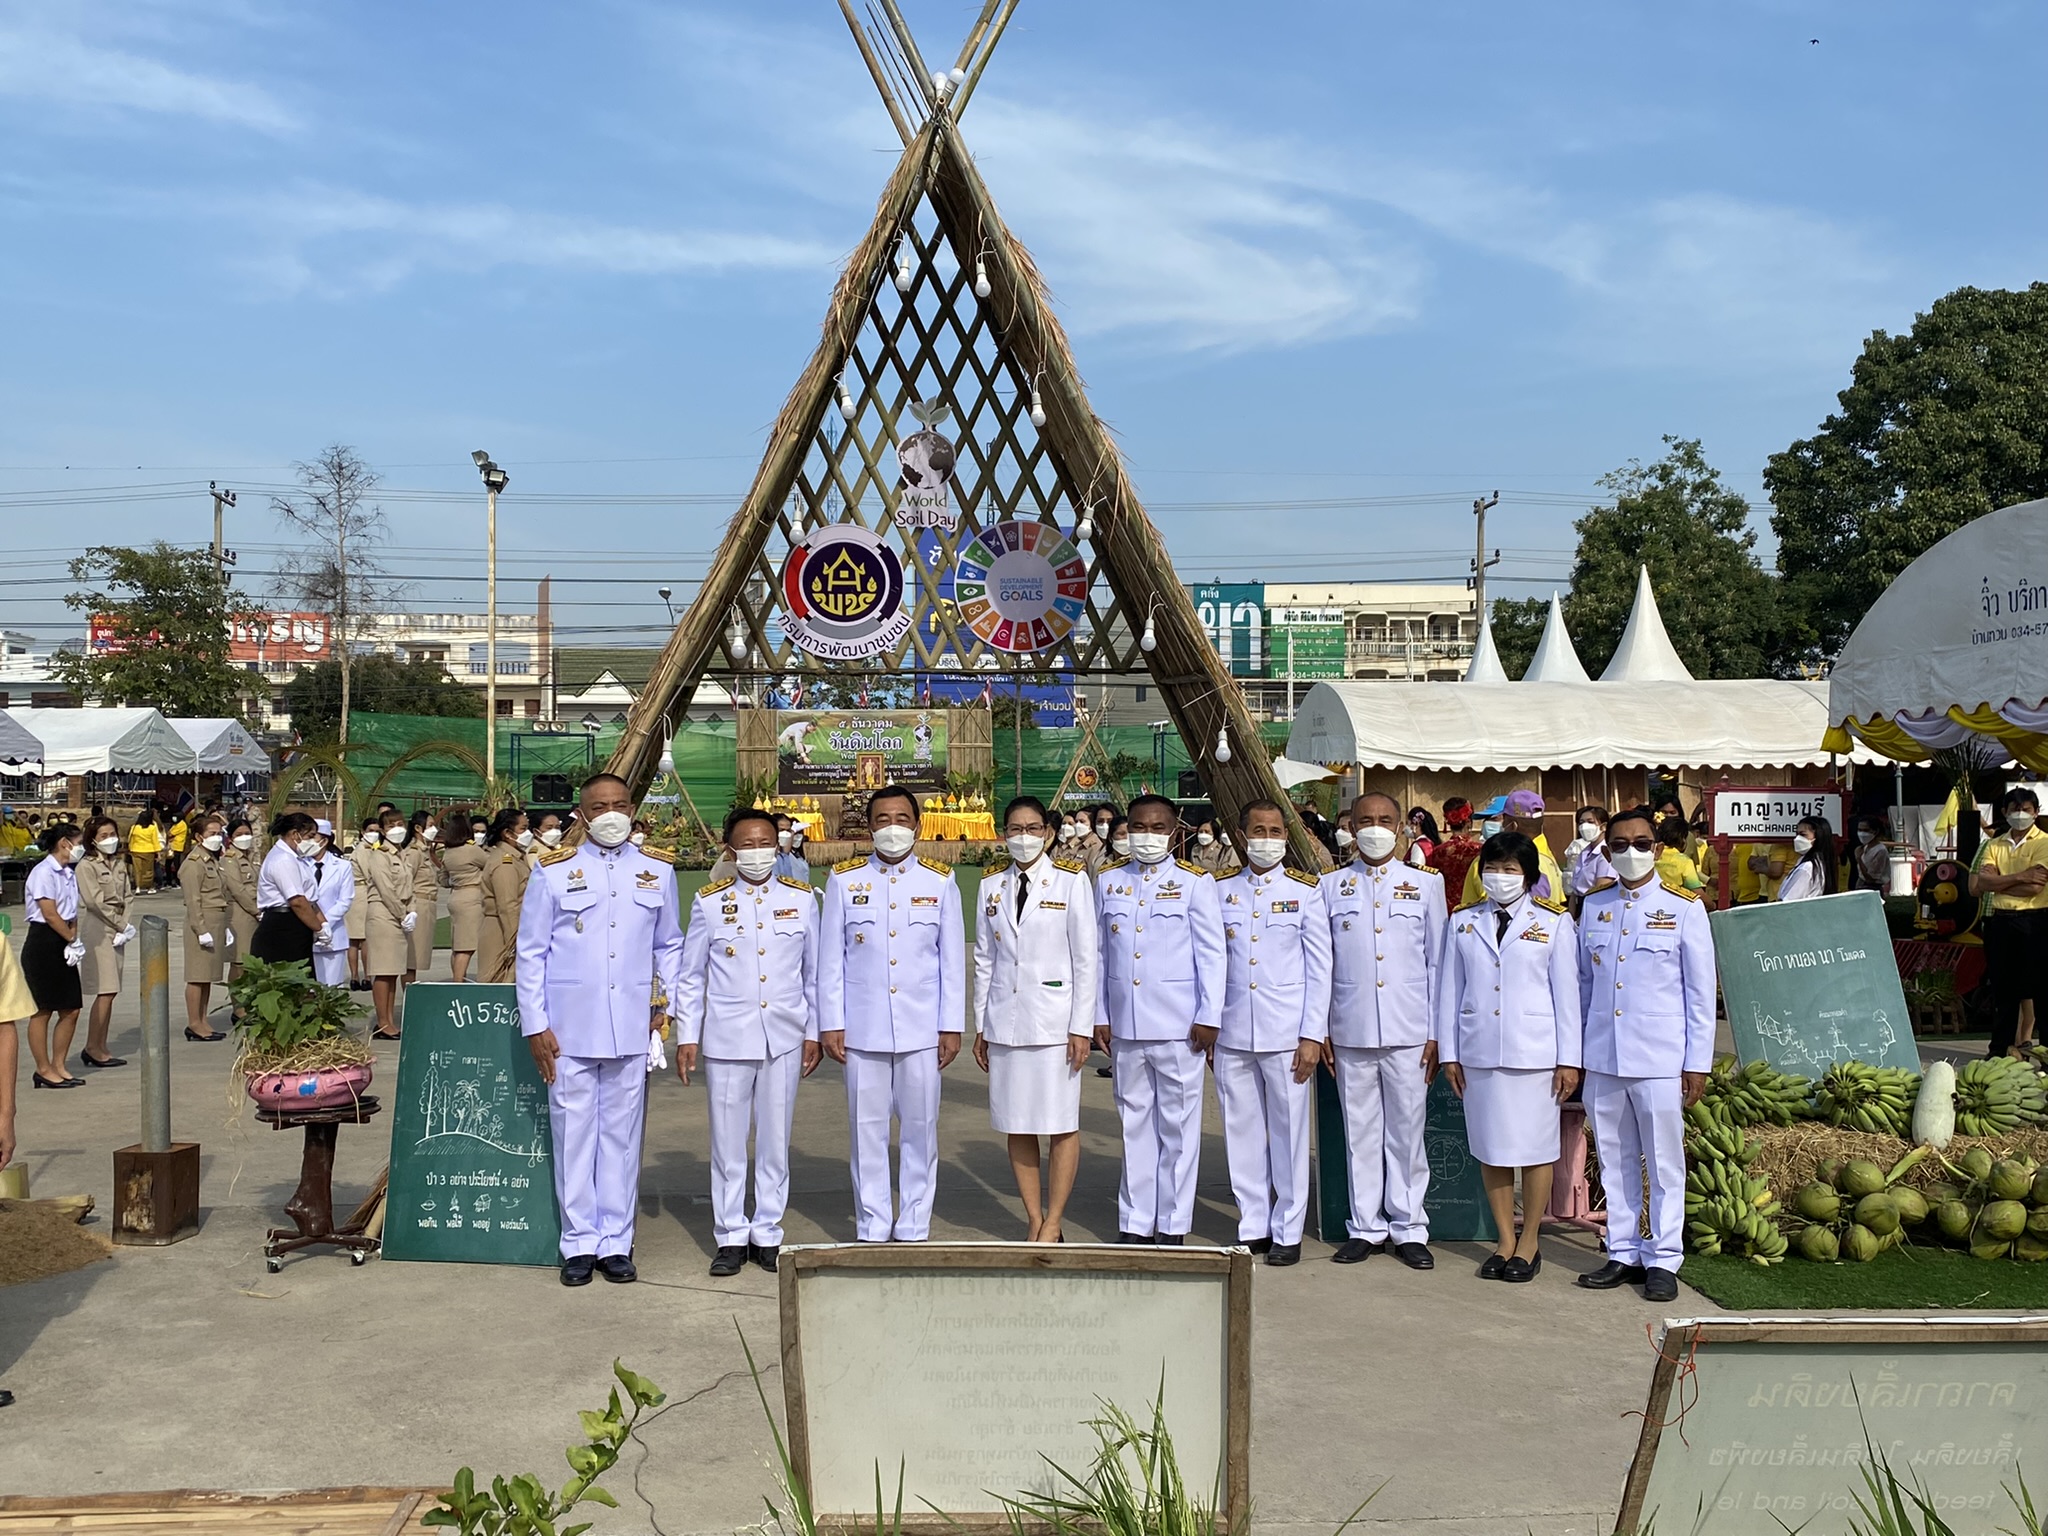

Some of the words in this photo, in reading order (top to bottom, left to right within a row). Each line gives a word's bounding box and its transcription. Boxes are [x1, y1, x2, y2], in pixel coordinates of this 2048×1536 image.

[904, 492, 948, 508] World
[896, 510, 926, 528] Soil
[928, 510, 958, 532] Day
[1000, 591, 1044, 602] GOALS
[778, 614, 911, 657] กรมการพัฒนาชุมชน
[852, 716, 893, 728] ธันวาคม
[828, 728, 904, 750] วันดินโลก
[840, 752, 857, 760] Worl
[1730, 796, 1826, 821] กาญจนบรี
[1738, 824, 1798, 832] KANCHANAB
[1753, 950, 1784, 972] โคก
[1784, 951, 1817, 970] หนอง
[1818, 948, 1836, 965] นา
[1836, 947, 1866, 962] โมเดล
[447, 999, 473, 1028] ป่า
[477, 1002, 490, 1023] 5
[493, 1002, 521, 1028] ระด
[426, 1171, 437, 1186] ป่า
[439, 1176, 446, 1186] 3
[450, 1171, 467, 1186] อย่าง
[468, 1169, 502, 1187] ประโยชน์
[502, 1178, 508, 1187] 4
[510, 1174, 530, 1188] อย่าง
[418, 1216, 438, 1228] พอกิน
[446, 1213, 464, 1228] พอใช้
[472, 1217, 491, 1232] พออยู่
